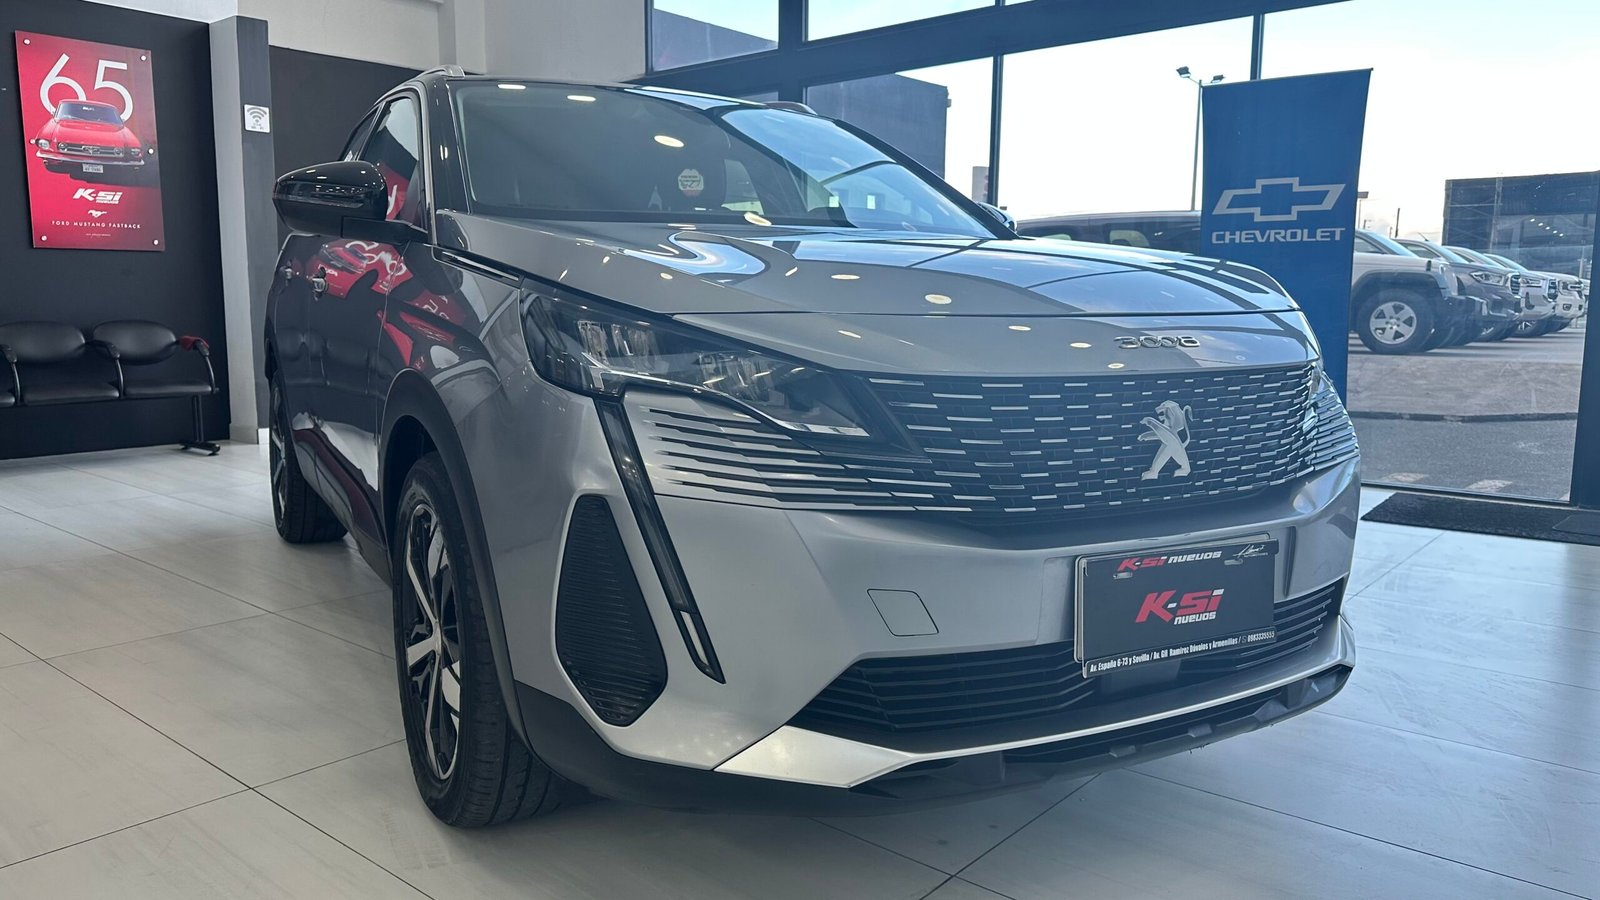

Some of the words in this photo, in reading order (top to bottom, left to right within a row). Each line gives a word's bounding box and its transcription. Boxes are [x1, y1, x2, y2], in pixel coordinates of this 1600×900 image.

[40, 53, 133, 123] 65
[1211, 227, 1346, 244] CHEVROLET
[1113, 335, 1200, 349] 3008
[1098, 659, 1117, 671] España
[1116, 656, 1129, 667] 6-73
[1132, 653, 1150, 664] Sevilla
